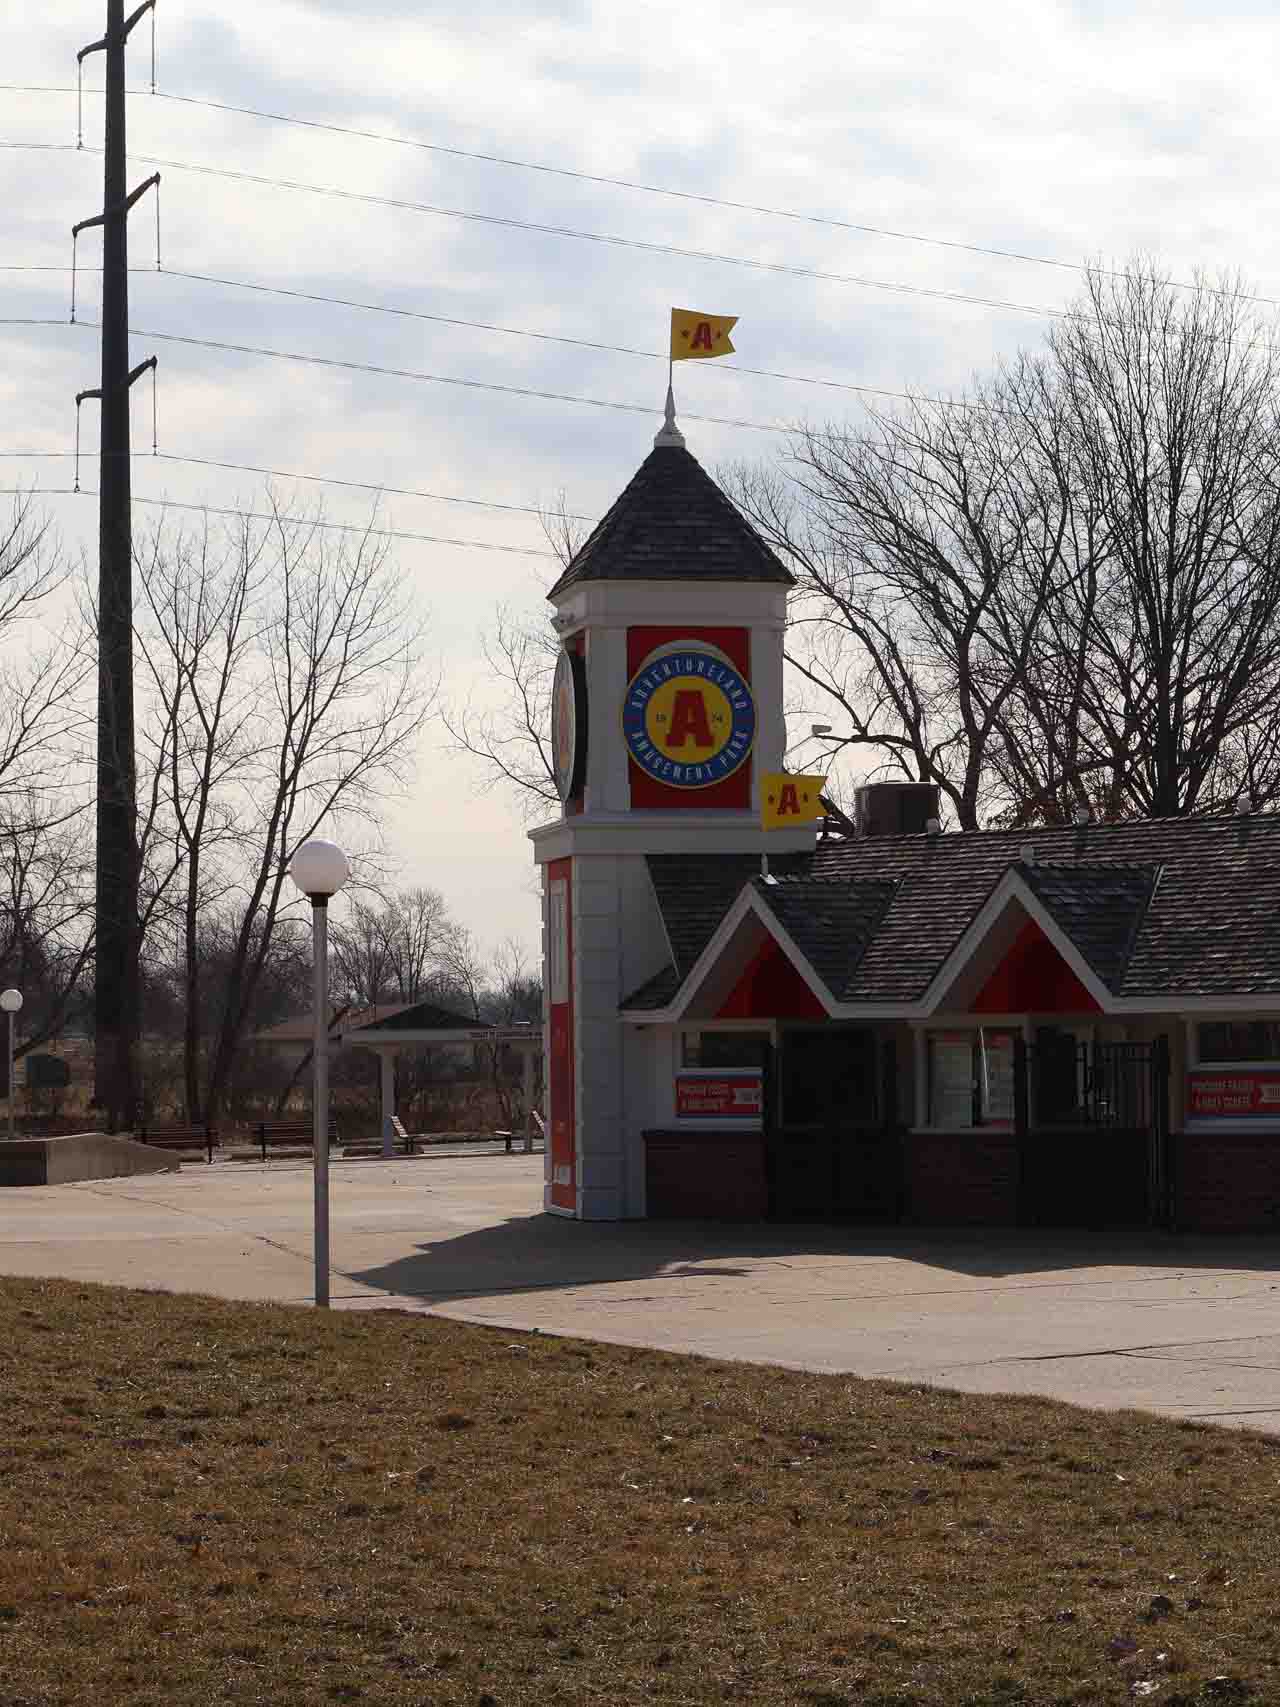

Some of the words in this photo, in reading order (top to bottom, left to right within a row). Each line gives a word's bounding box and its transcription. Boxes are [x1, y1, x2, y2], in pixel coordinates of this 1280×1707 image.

[690, 322, 713, 351] A
[632, 658, 748, 709] ADVENTURELAND
[665, 690, 715, 747] A
[631, 731, 713, 782] AMUSEMENT
[719, 730, 748, 769] PARK
[776, 783, 801, 816] A
